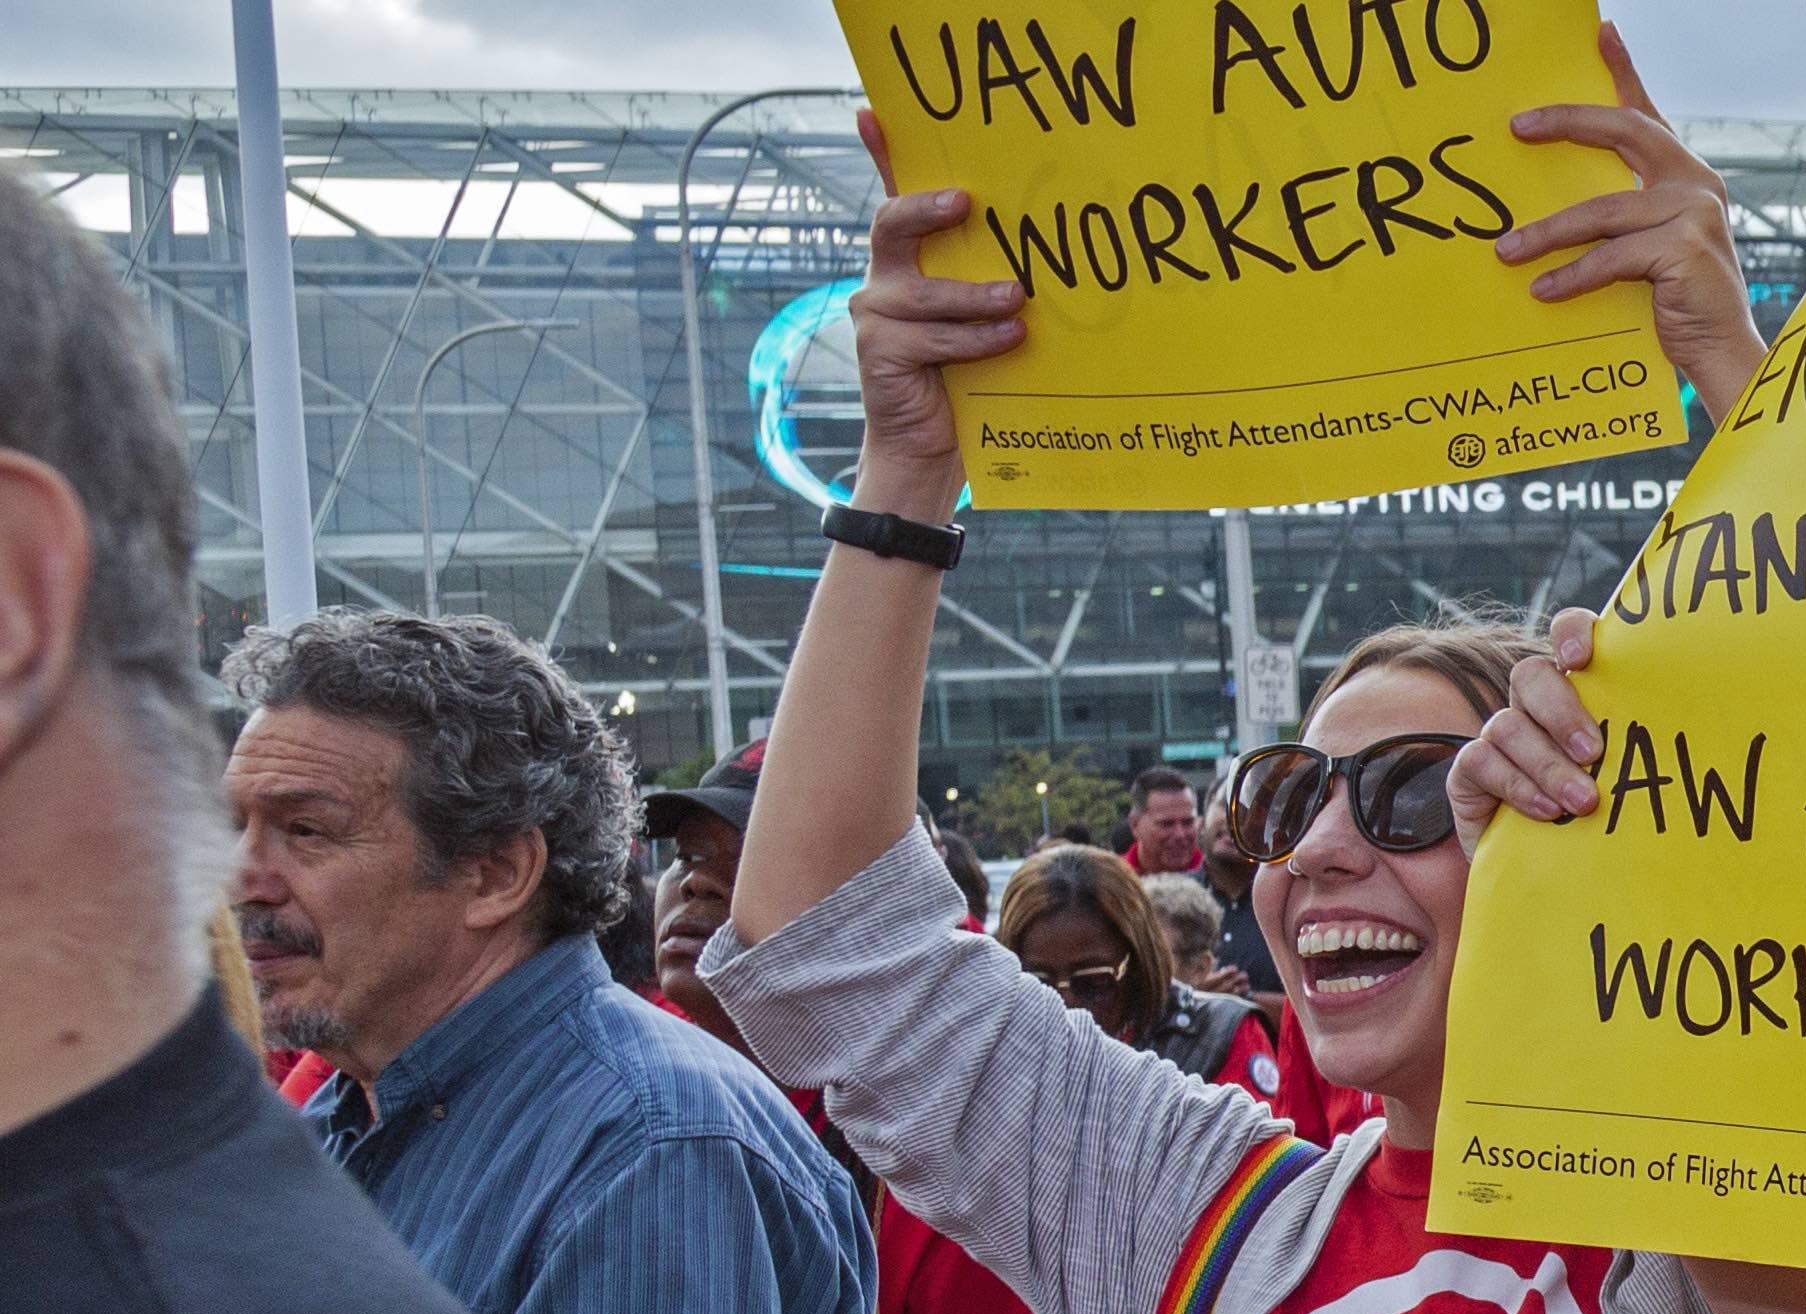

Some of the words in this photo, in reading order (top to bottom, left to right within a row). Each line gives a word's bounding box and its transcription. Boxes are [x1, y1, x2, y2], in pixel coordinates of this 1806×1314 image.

[891, 17, 1137, 132] UAW
[1212, 0, 1490, 114] AUTO
[985, 134, 1514, 298] WORKERS
[981, 422, 1113, 451] Association
[1119, 423, 1144, 451] of
[1149, 422, 1222, 457] Flight
[1228, 387, 1504, 448] Attendants-CWA,
[1508, 360, 1648, 409] AFL-CIO
[1495, 410, 1662, 456] afacwa.org
[1462, 1135, 1635, 1179] Association
[1647, 1152, 1678, 1182] of
[1686, 1154, 1758, 1197] Flight
